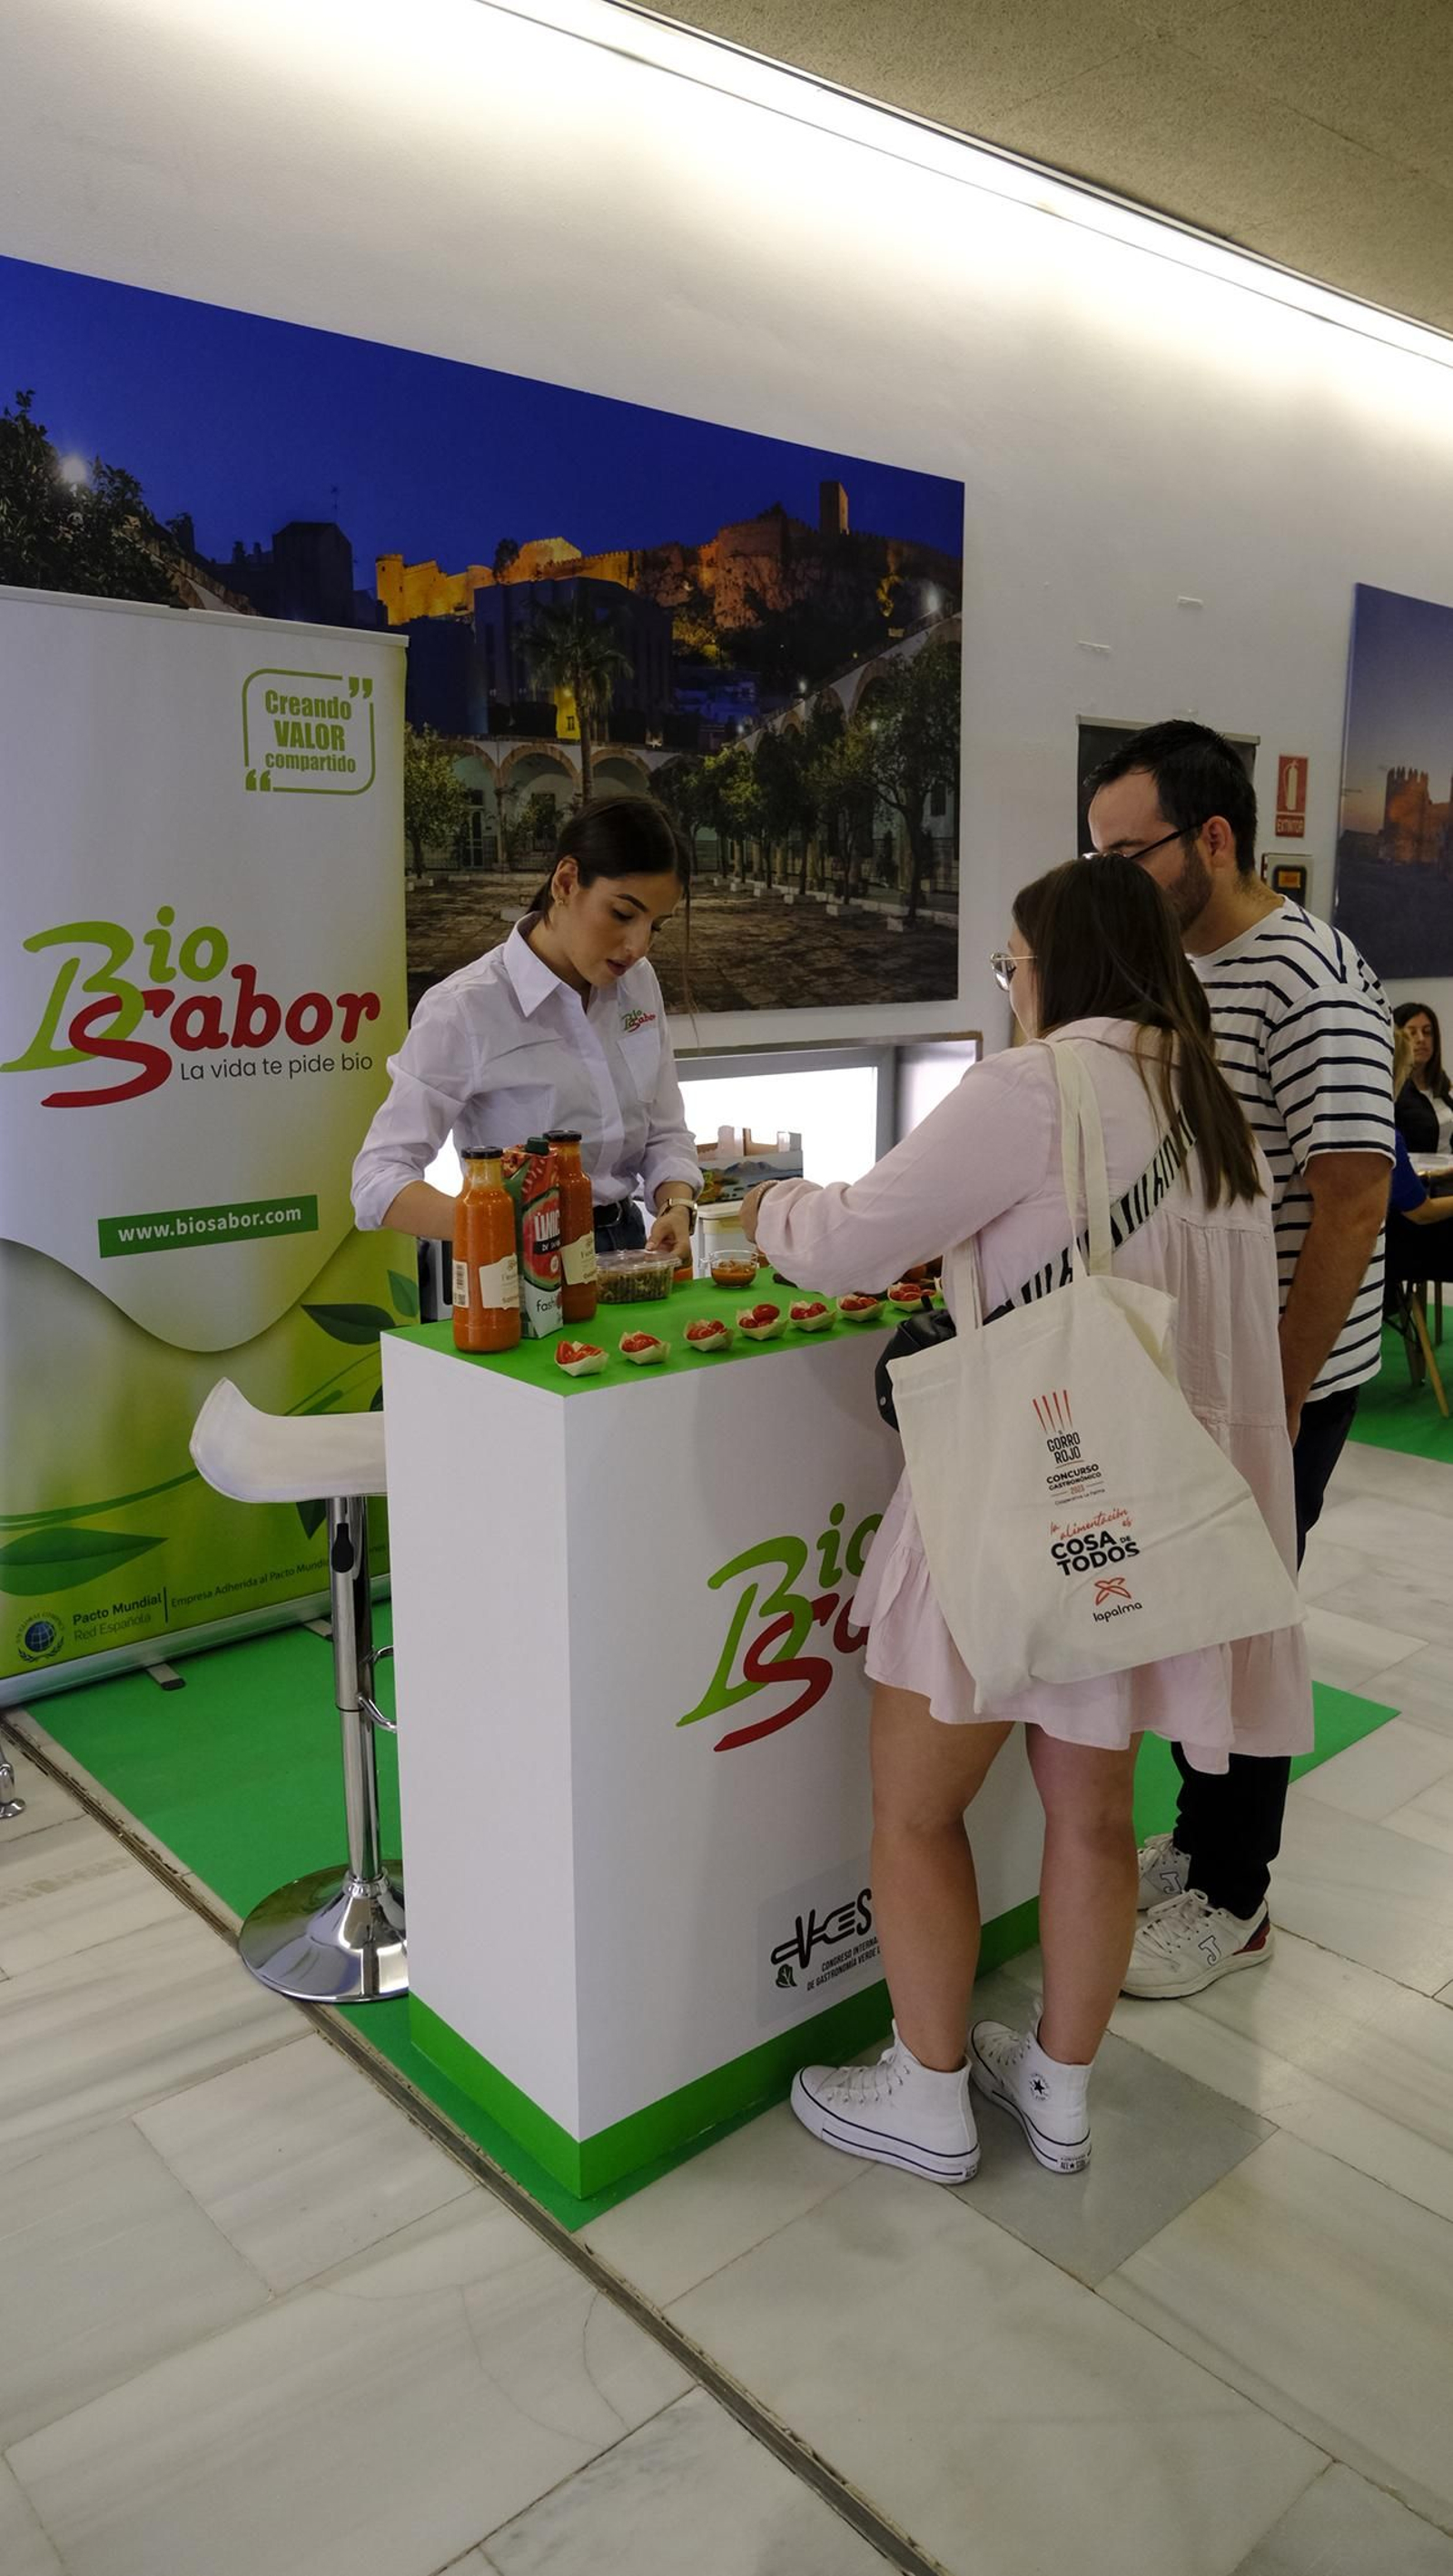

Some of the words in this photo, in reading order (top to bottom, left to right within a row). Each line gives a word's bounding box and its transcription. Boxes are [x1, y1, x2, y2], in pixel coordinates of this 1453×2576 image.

[265, 689, 351, 720] Creando
[273, 720, 345, 752] VALOR
[264, 753, 356, 774] compartido
[1, 906, 229, 1072] Bio
[41, 964, 381, 1108] Sabor
[181, 1063, 204, 1081] La
[211, 1059, 256, 1078] vida
[262, 1058, 282, 1074] te
[289, 1055, 335, 1080] pide
[341, 1052, 373, 1071] bio
[118, 1205, 301, 1243] www.biosabor.com
[1047, 1432, 1081, 1452] GORRO
[1054, 1446, 1081, 1464] ROJO
[1046, 1464, 1100, 1484] CONCURSO
[1052, 1531, 1117, 1559] COSA
[1120, 1535, 1132, 1544] DE
[1056, 1542, 1140, 1576] TODOS
[172, 1590, 213, 1607] Empresa
[214, 1578, 257, 1596] Adherida
[259, 1574, 268, 1584] al
[270, 1568, 294, 1581] Pacto
[73, 1610, 109, 1625] Pacto
[113, 1593, 162, 1615] Mundial
[1092, 1602, 1142, 1623] lapalma
[74, 1628, 97, 1641] Red
[100, 1613, 151, 1633] Española
